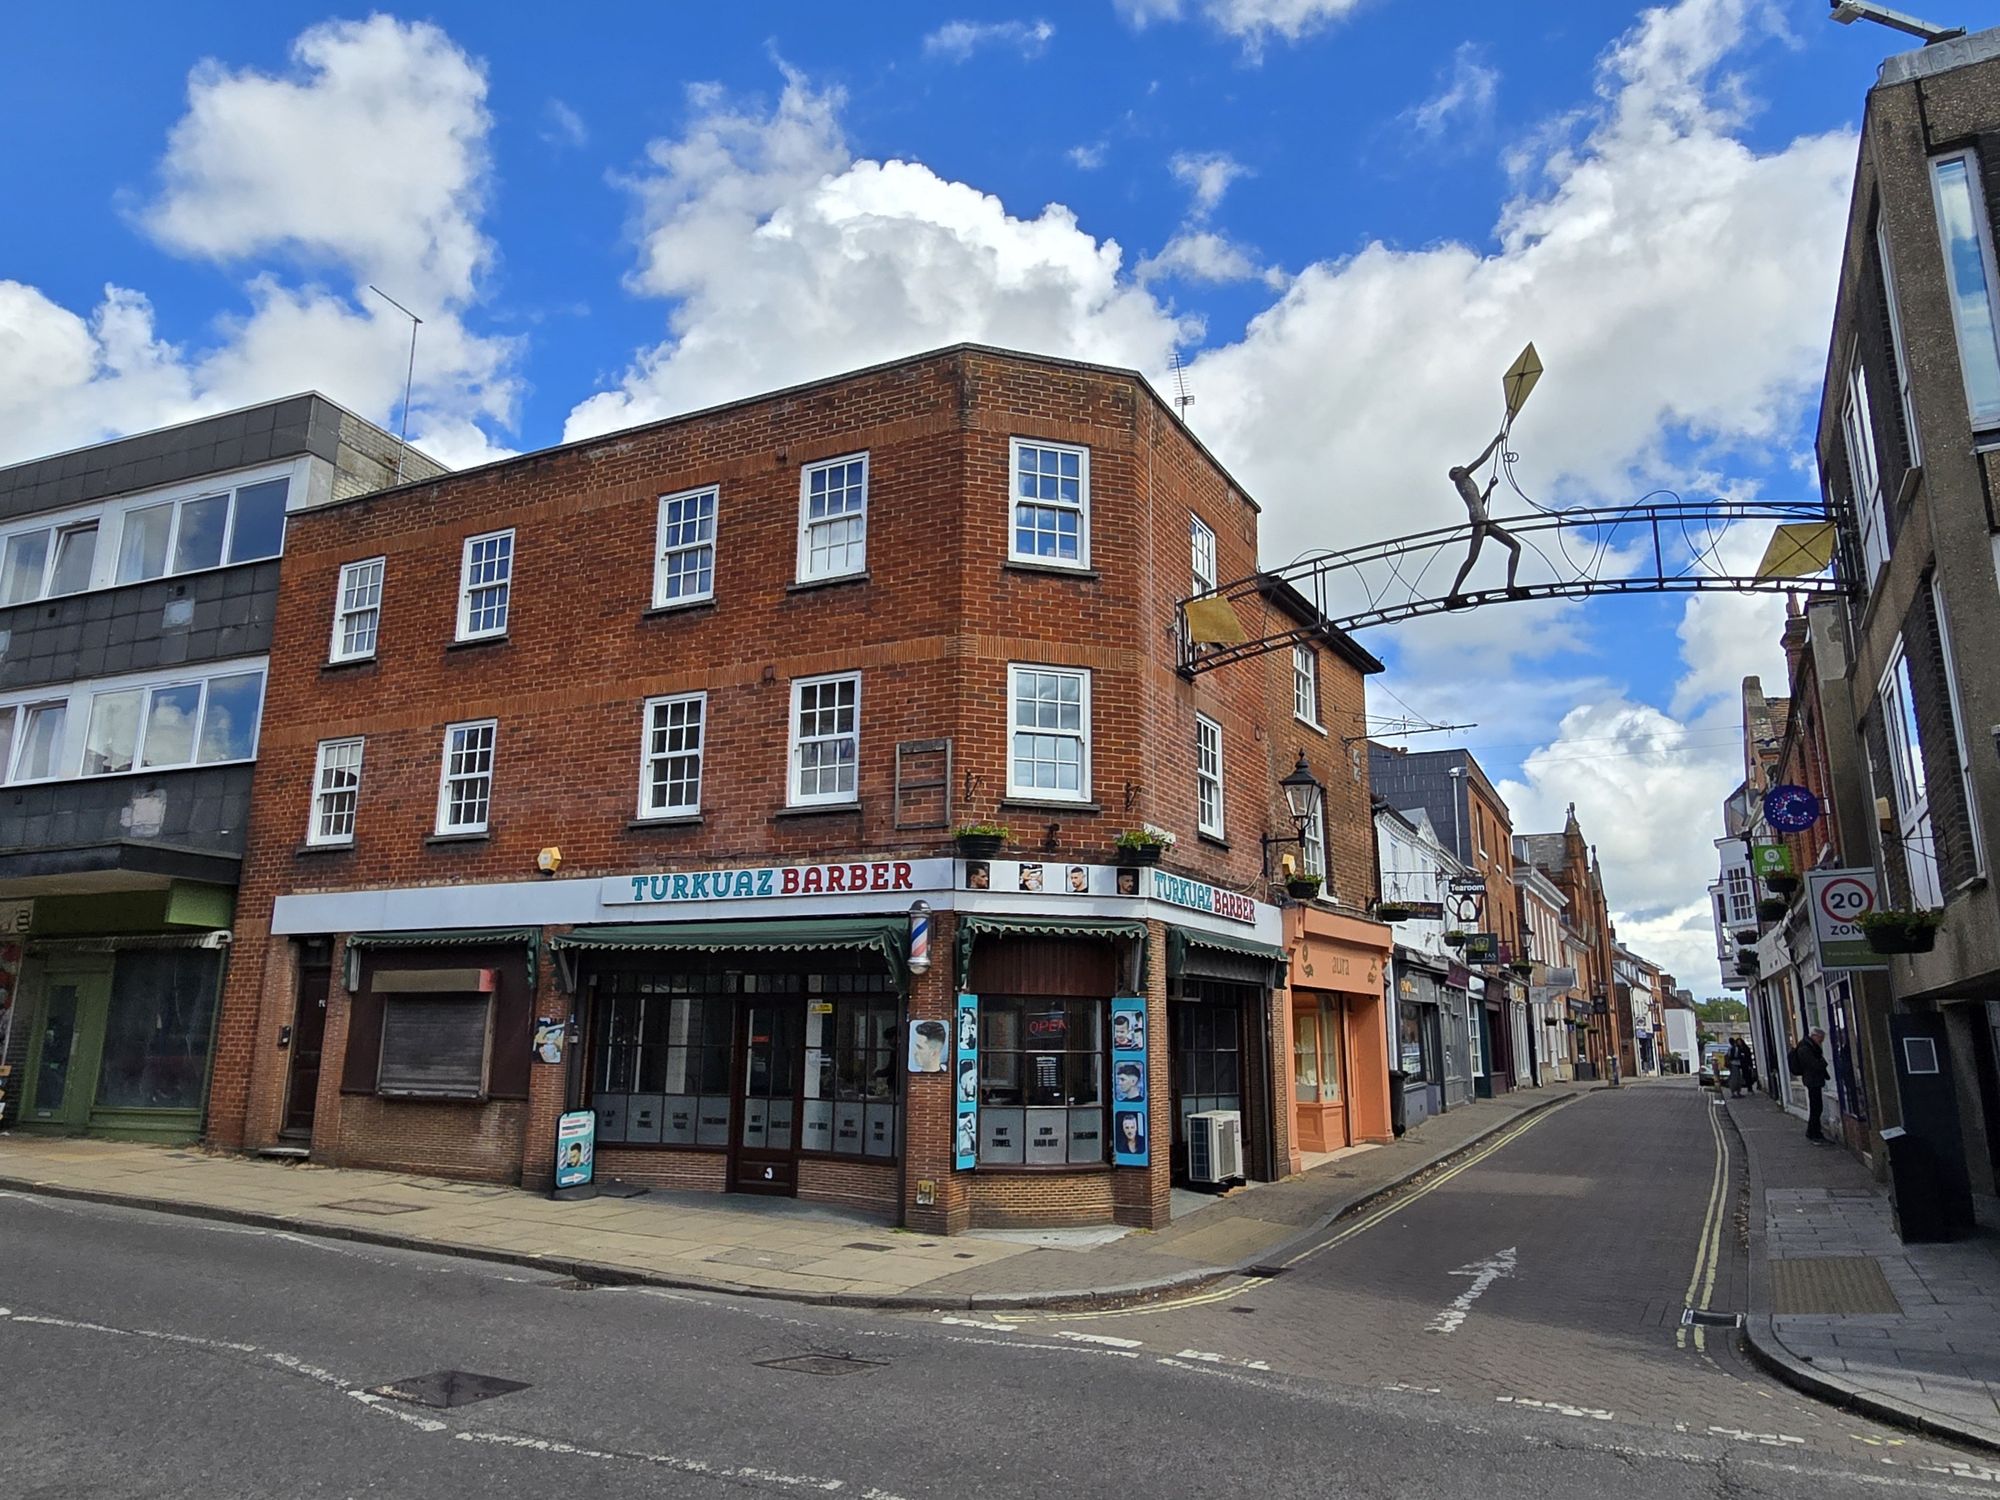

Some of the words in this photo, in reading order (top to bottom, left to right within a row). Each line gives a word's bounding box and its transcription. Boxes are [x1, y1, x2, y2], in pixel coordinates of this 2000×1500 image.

[631, 869, 774, 901] TURKUAZ
[780, 862, 913, 895] BARBER
[1450, 884, 1485, 892] Tearoom
[1154, 871, 1213, 912] TURKUAZ
[1213, 889, 1256, 922] BARBER
[1830, 891, 1864, 909] 20
[1830, 924, 1863, 936] ZON
[1332, 956, 1350, 976] aura
[1029, 1019, 1067, 1034] OPEN
